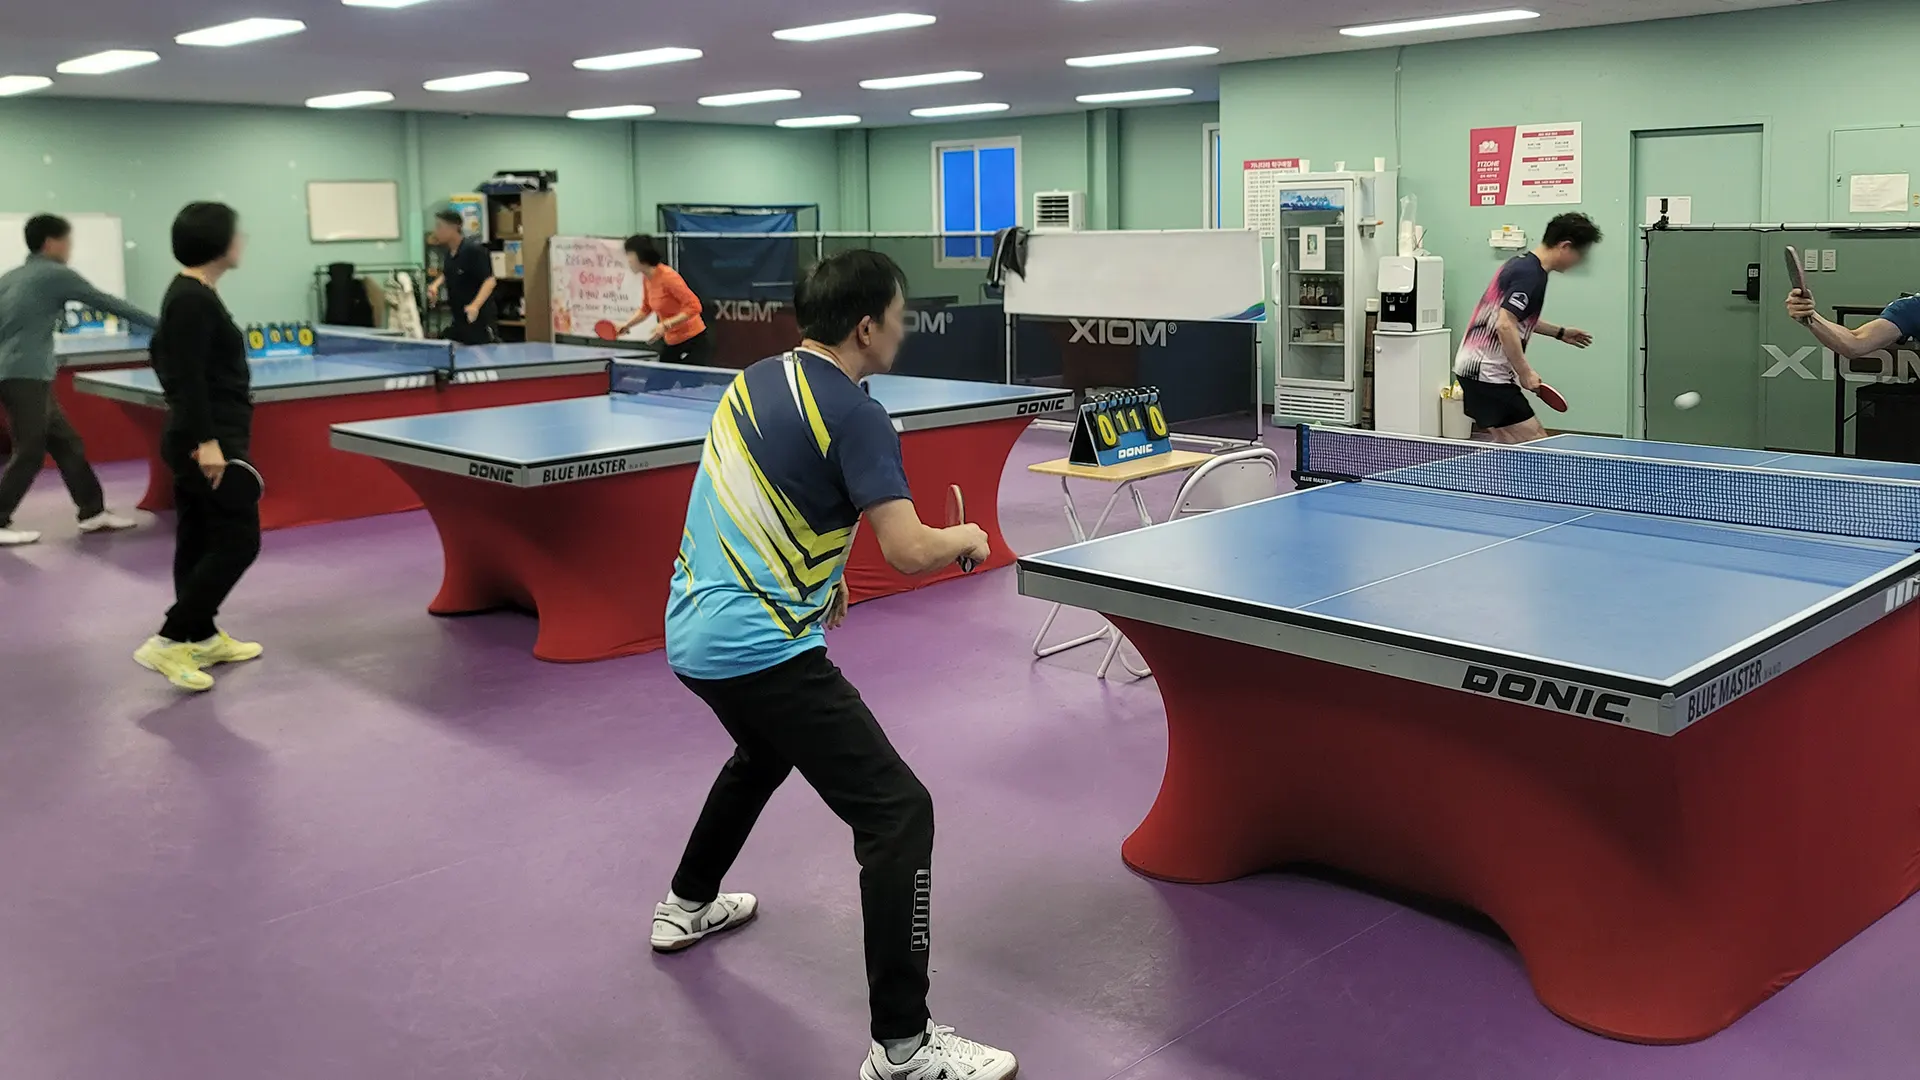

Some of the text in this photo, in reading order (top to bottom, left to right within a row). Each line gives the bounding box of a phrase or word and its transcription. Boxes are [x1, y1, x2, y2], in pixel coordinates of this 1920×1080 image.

[715, 300, 772, 323] XIOM
[903, 310, 946, 335] OM
[1068, 318, 1166, 347] XIOM
[1017, 399, 1065, 415] DONIC
[1118, 443, 1153, 459] DONIC
[468, 462, 514, 483] DONIC
[543, 466, 575, 483] BLUE
[577, 458, 626, 478] MASTER
[1461, 665, 1632, 723] DONIC
[1687, 683, 1717, 723] BLUE
[1719, 659, 1762, 706] MASTER
